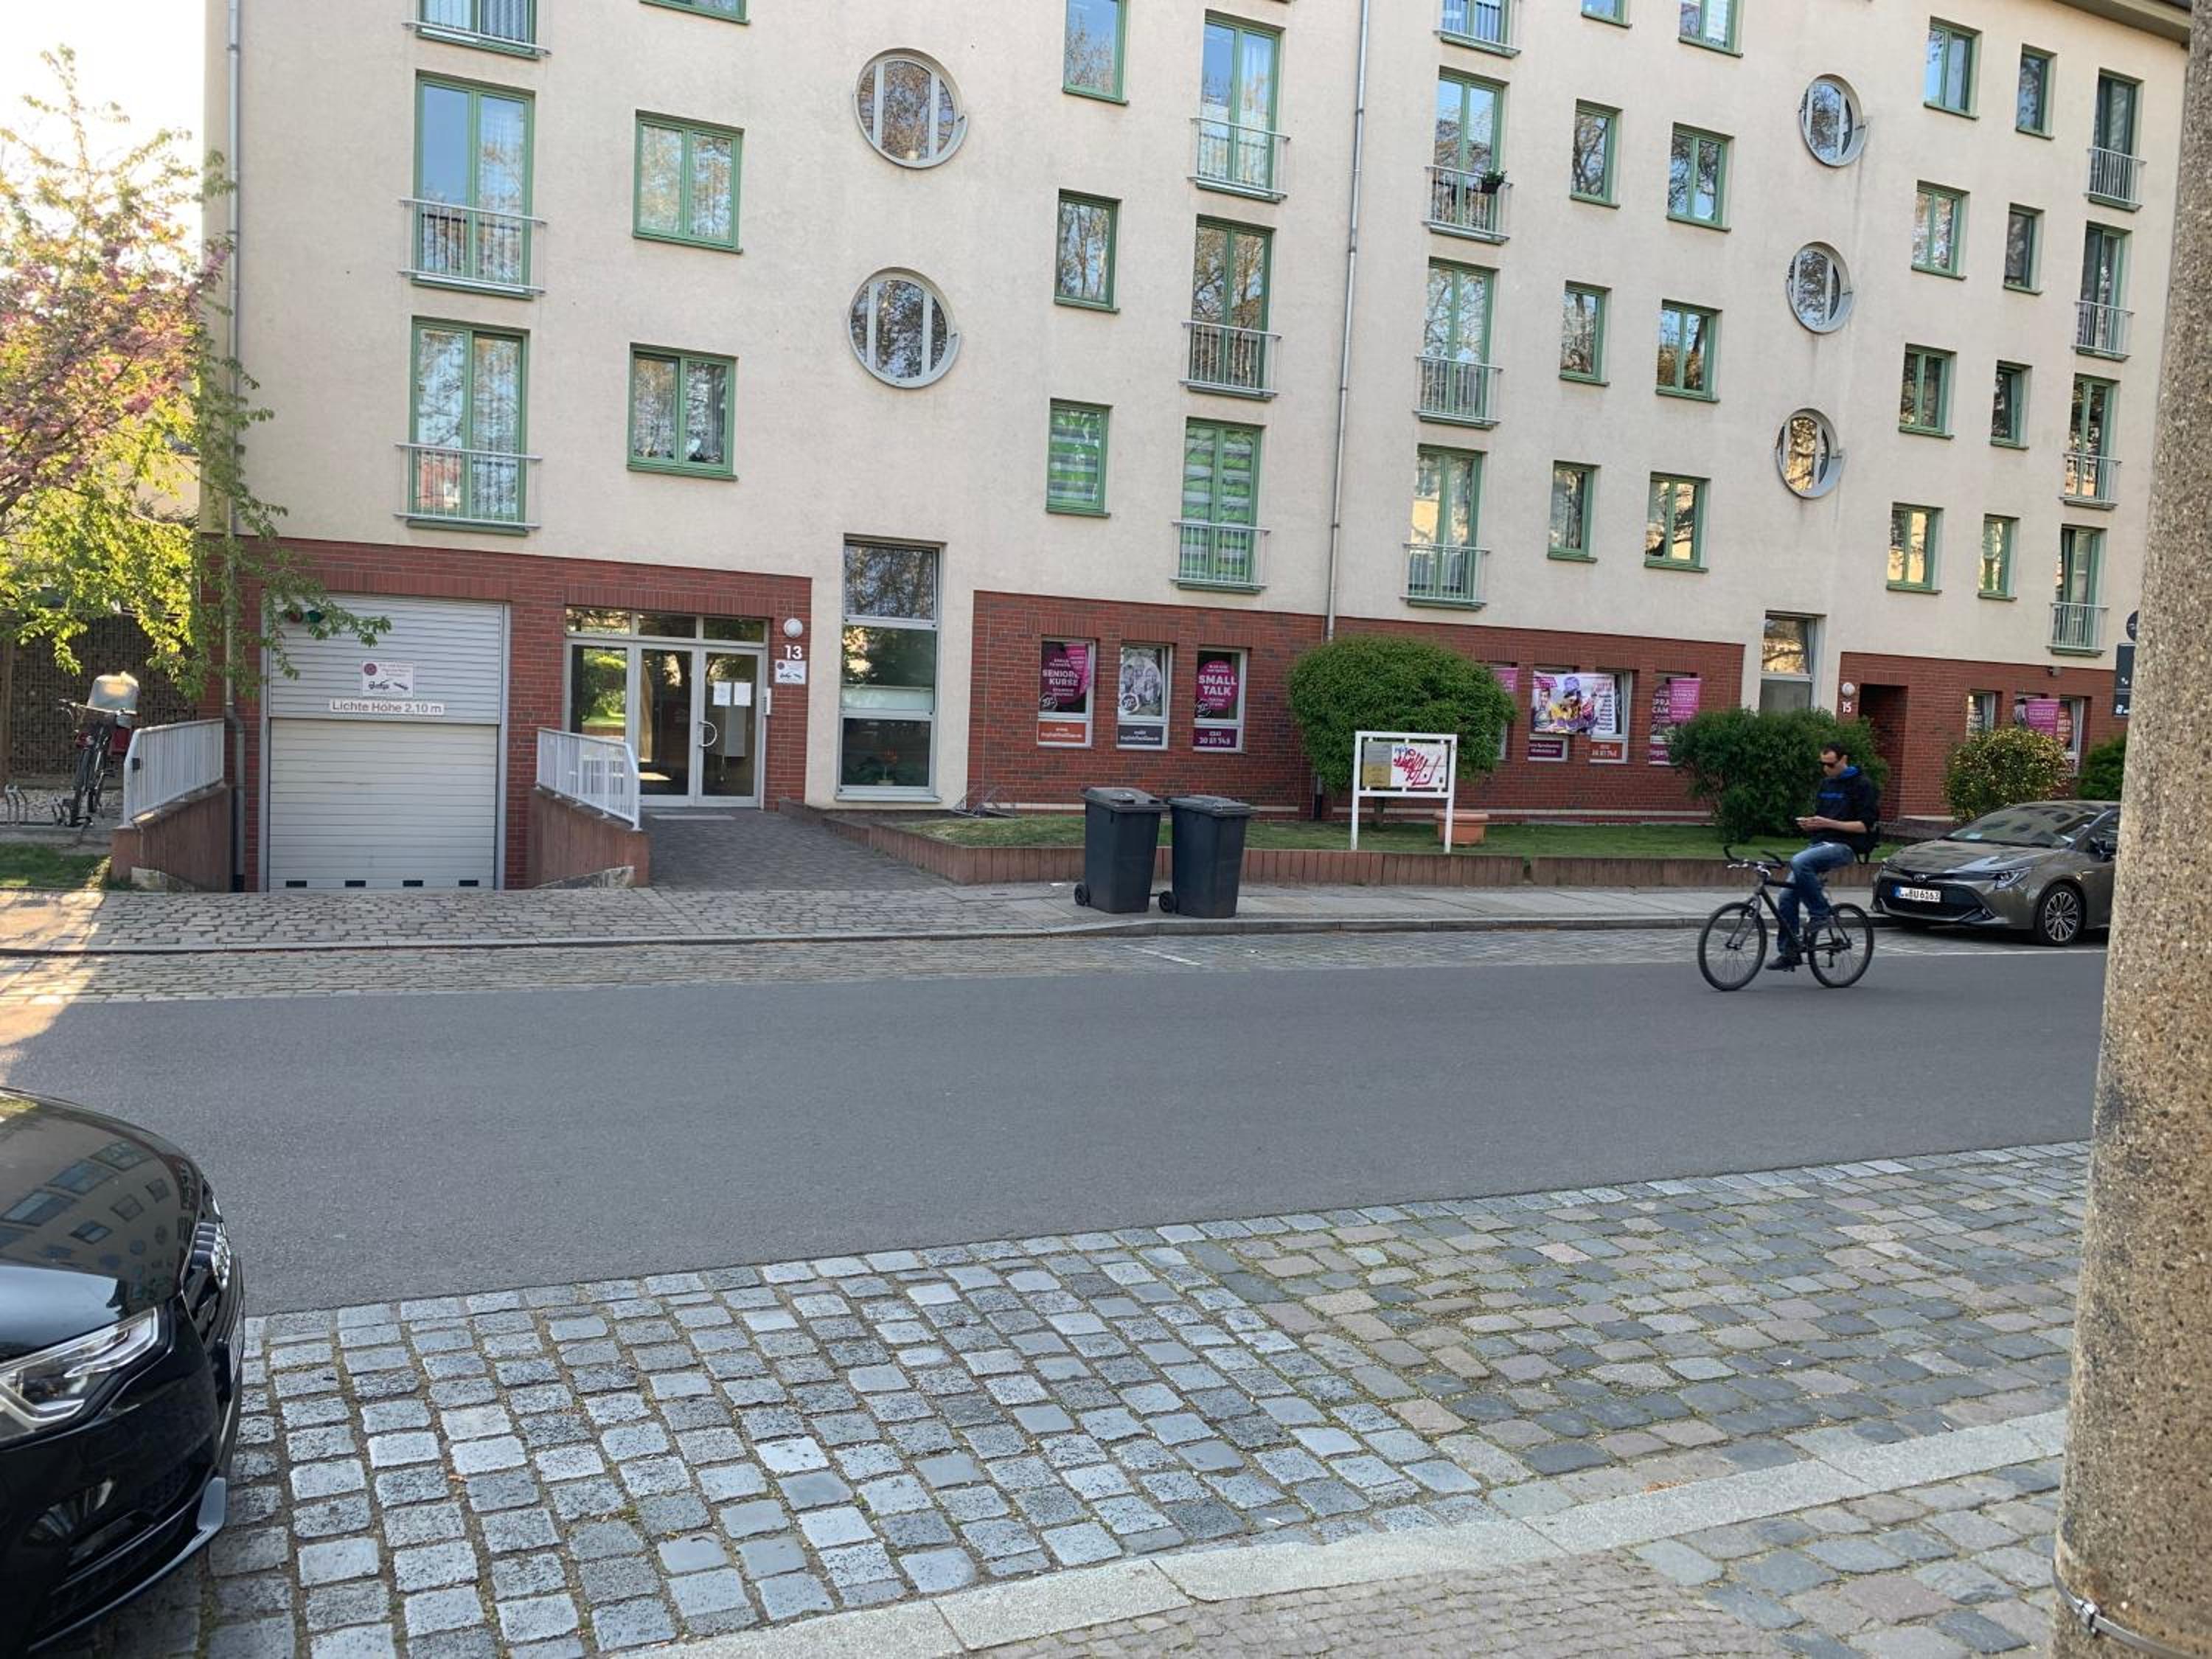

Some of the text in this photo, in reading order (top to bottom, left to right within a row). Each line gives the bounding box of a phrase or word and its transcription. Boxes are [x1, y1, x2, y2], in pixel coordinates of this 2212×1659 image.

[785, 644, 802, 660] 13
[1049, 678, 1079, 686] KURSE
[1198, 675, 1237, 685] SMALL
[1203, 686, 1231, 696] TALK
[333, 701, 368, 712] Lichte
[371, 701, 402, 712] Höhe
[406, 703, 428, 714] 2,10
[1842, 701, 1851, 713] 15
